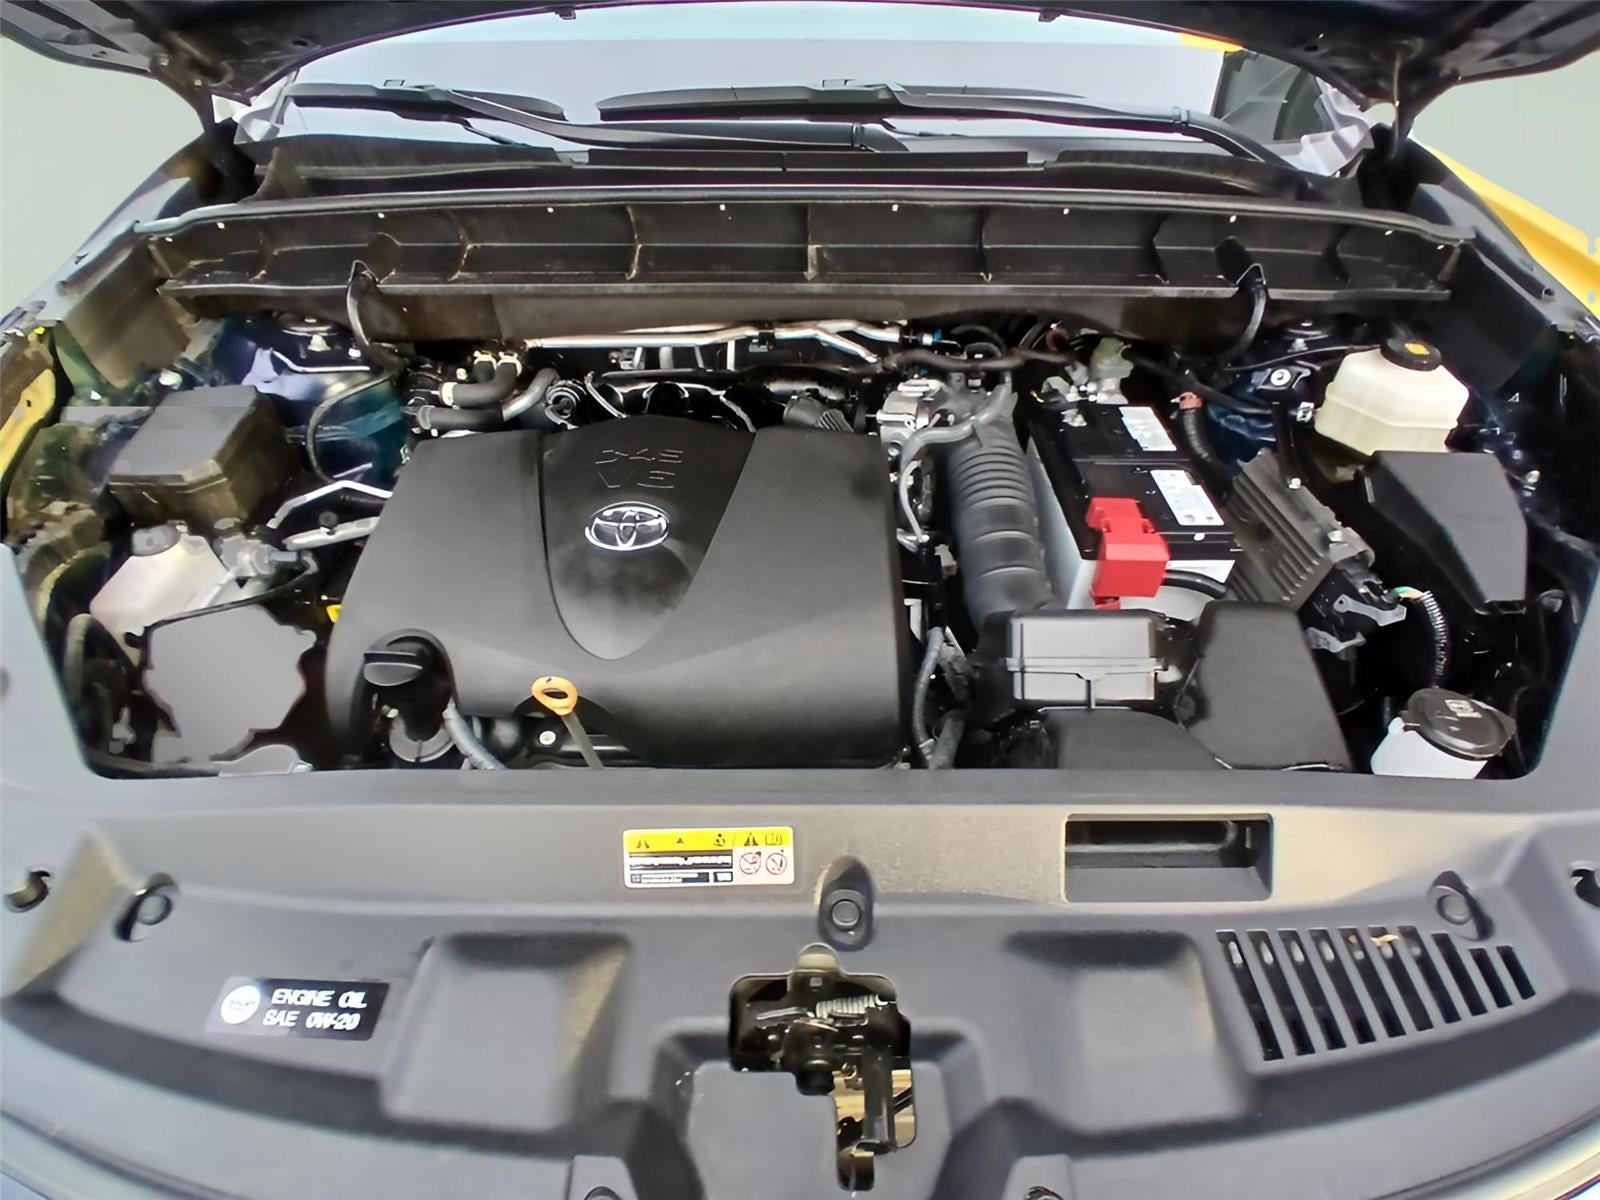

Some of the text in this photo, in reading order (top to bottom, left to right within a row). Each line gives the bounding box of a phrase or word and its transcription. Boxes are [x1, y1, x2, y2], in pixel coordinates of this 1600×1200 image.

[271, 989, 335, 1007] ENGINE
[338, 990, 368, 1009] OIL
[262, 1009, 300, 1027] SAE
